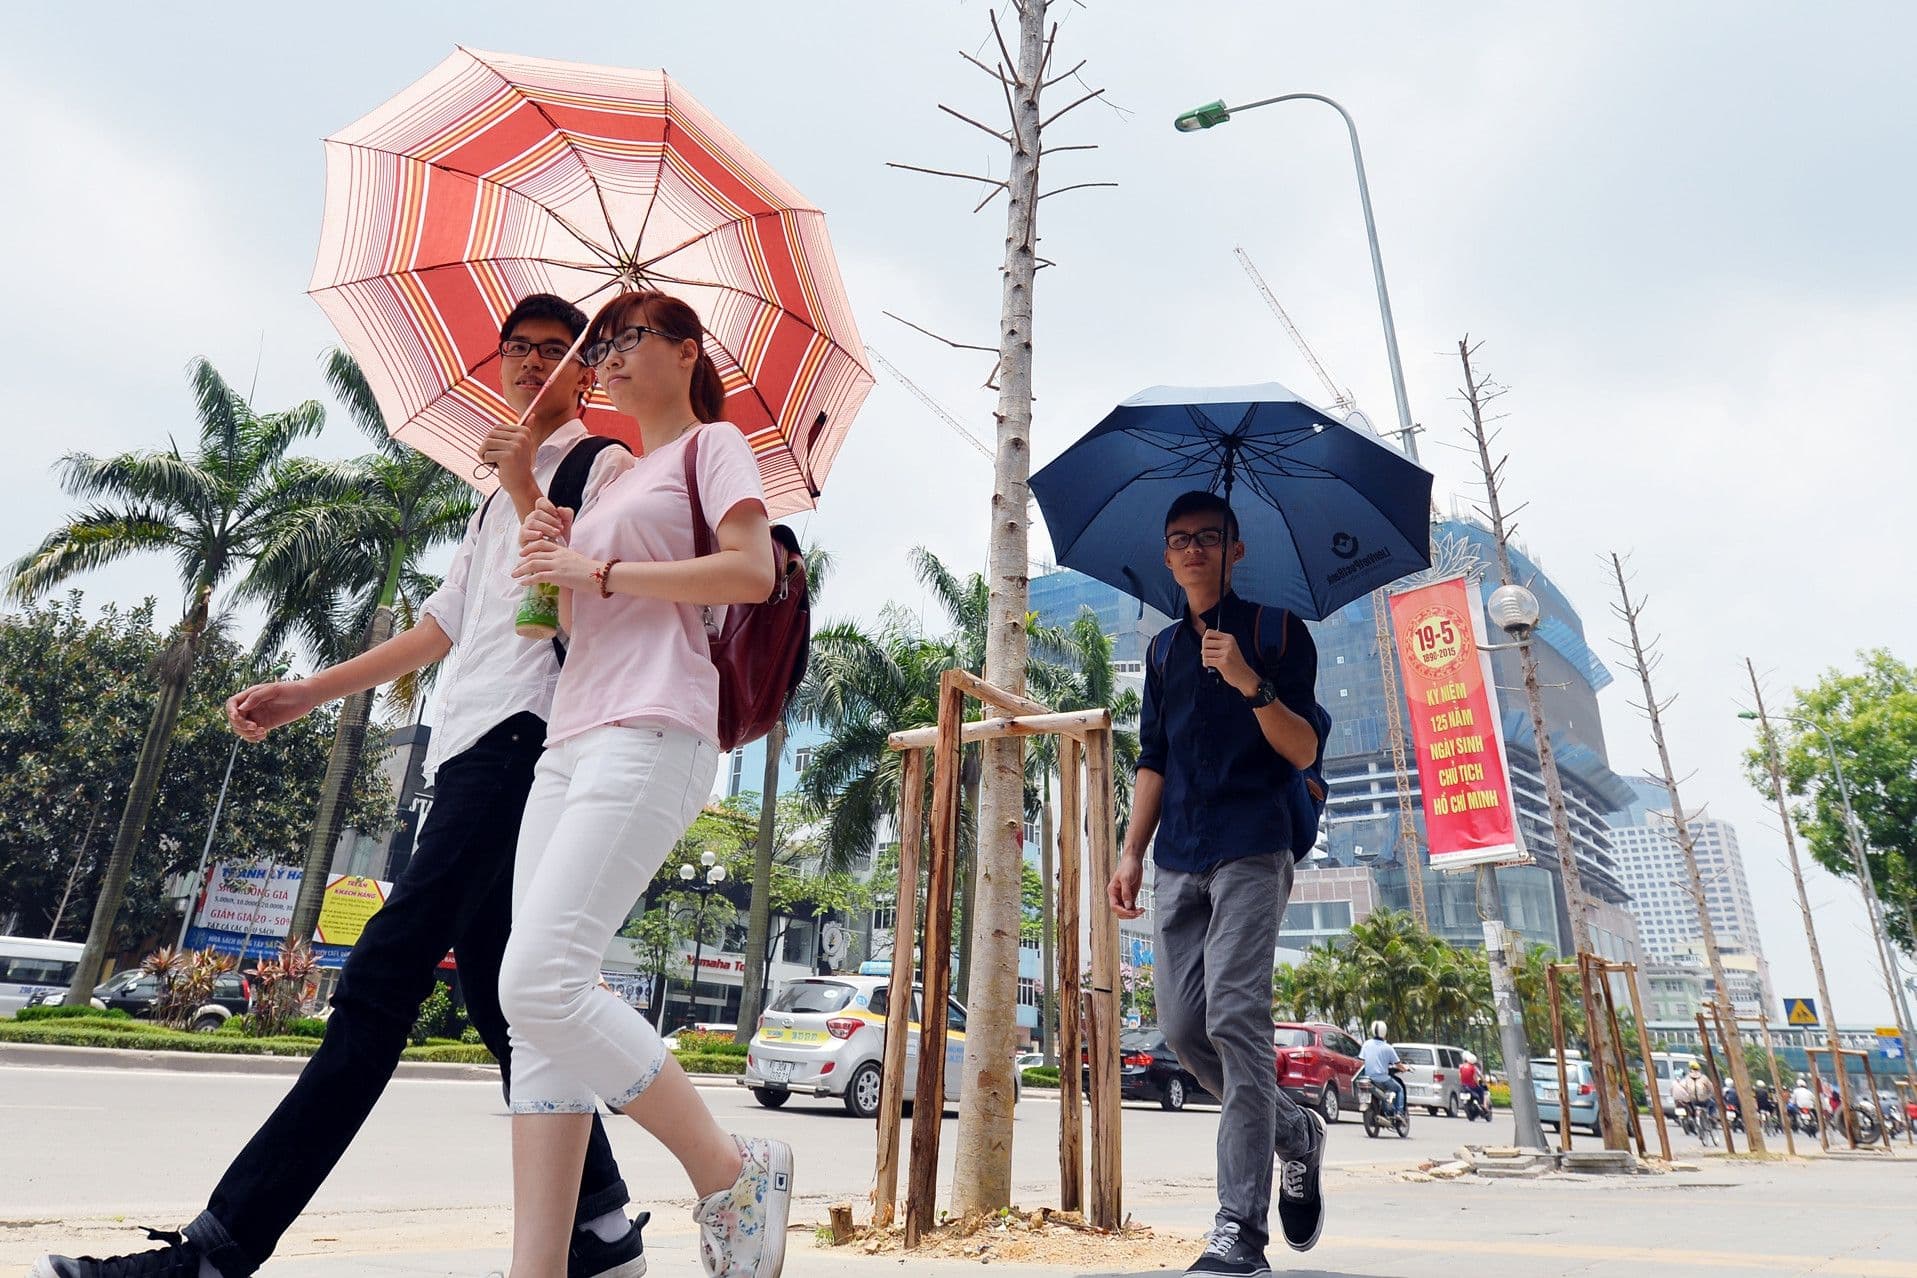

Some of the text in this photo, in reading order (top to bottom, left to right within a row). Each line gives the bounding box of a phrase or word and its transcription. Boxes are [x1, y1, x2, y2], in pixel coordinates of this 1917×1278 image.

[1415, 620, 1455, 651] 19-5
[1423, 647, 1456, 663] 1890-2015
[1441, 681, 1467, 704] NIỆM
[1430, 706, 1474, 733] 125 NĂM
[1430, 735, 1485, 760] NGÀY SINH
[1438, 760, 1484, 787] CHỦ TỊCH
[1433, 789, 1499, 816] HỒ CHÍ MINH
[255, 915, 267, 924] 20
[735, 960, 747, 972] To
